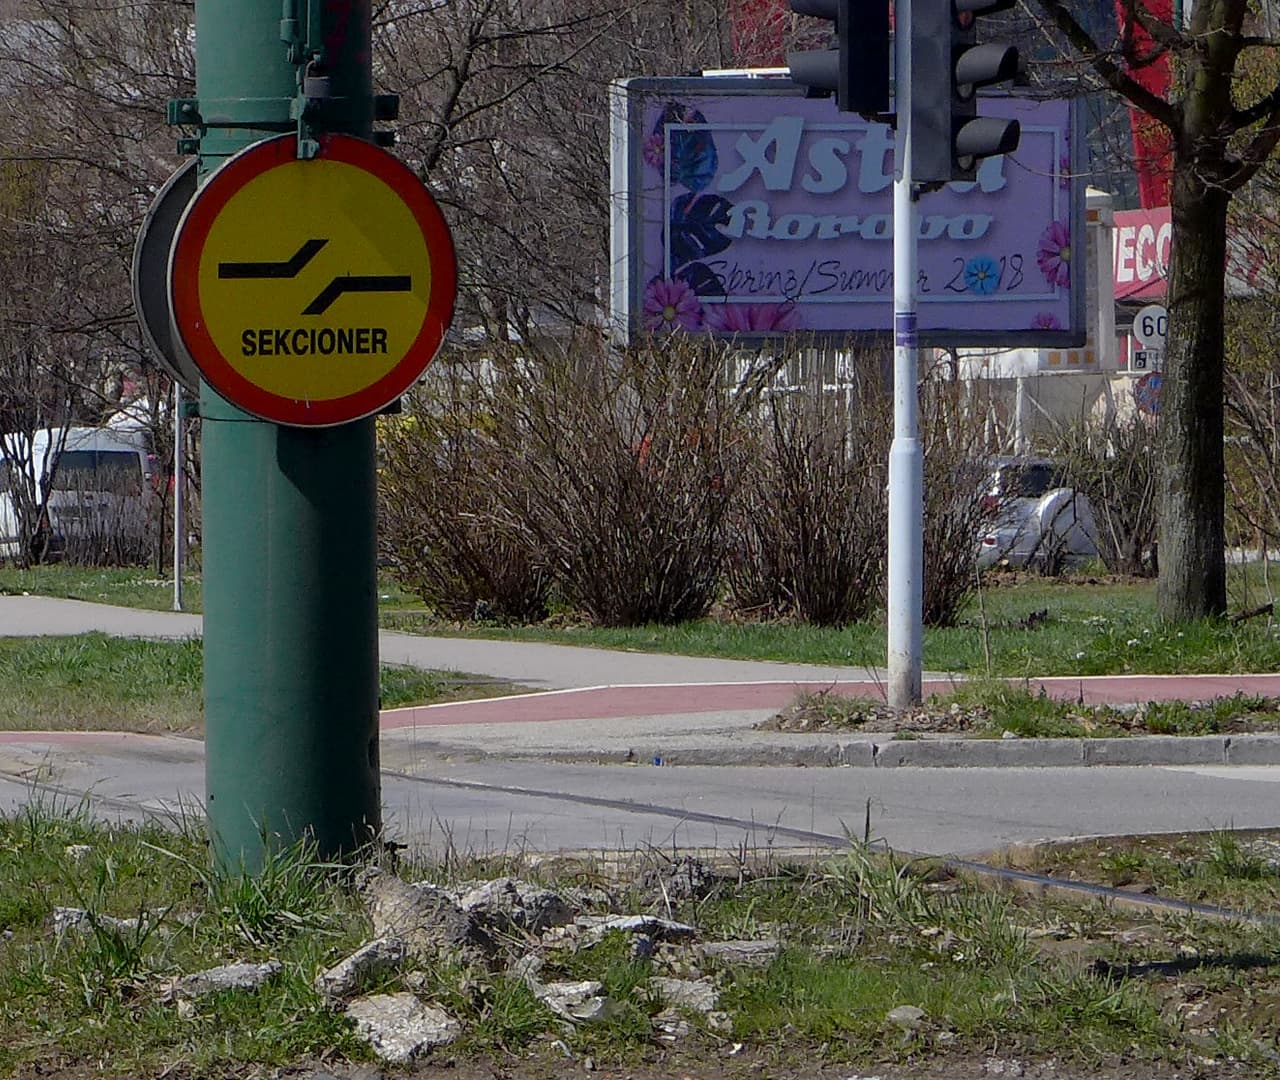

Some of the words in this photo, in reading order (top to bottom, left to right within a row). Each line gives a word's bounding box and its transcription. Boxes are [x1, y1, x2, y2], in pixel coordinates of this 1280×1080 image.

[717, 116, 1008, 193] Ast
[706, 258, 930, 312] Spring/Summr
[241, 327, 388, 357] SEKCIONER
[1142, 316, 1167, 336] 60
